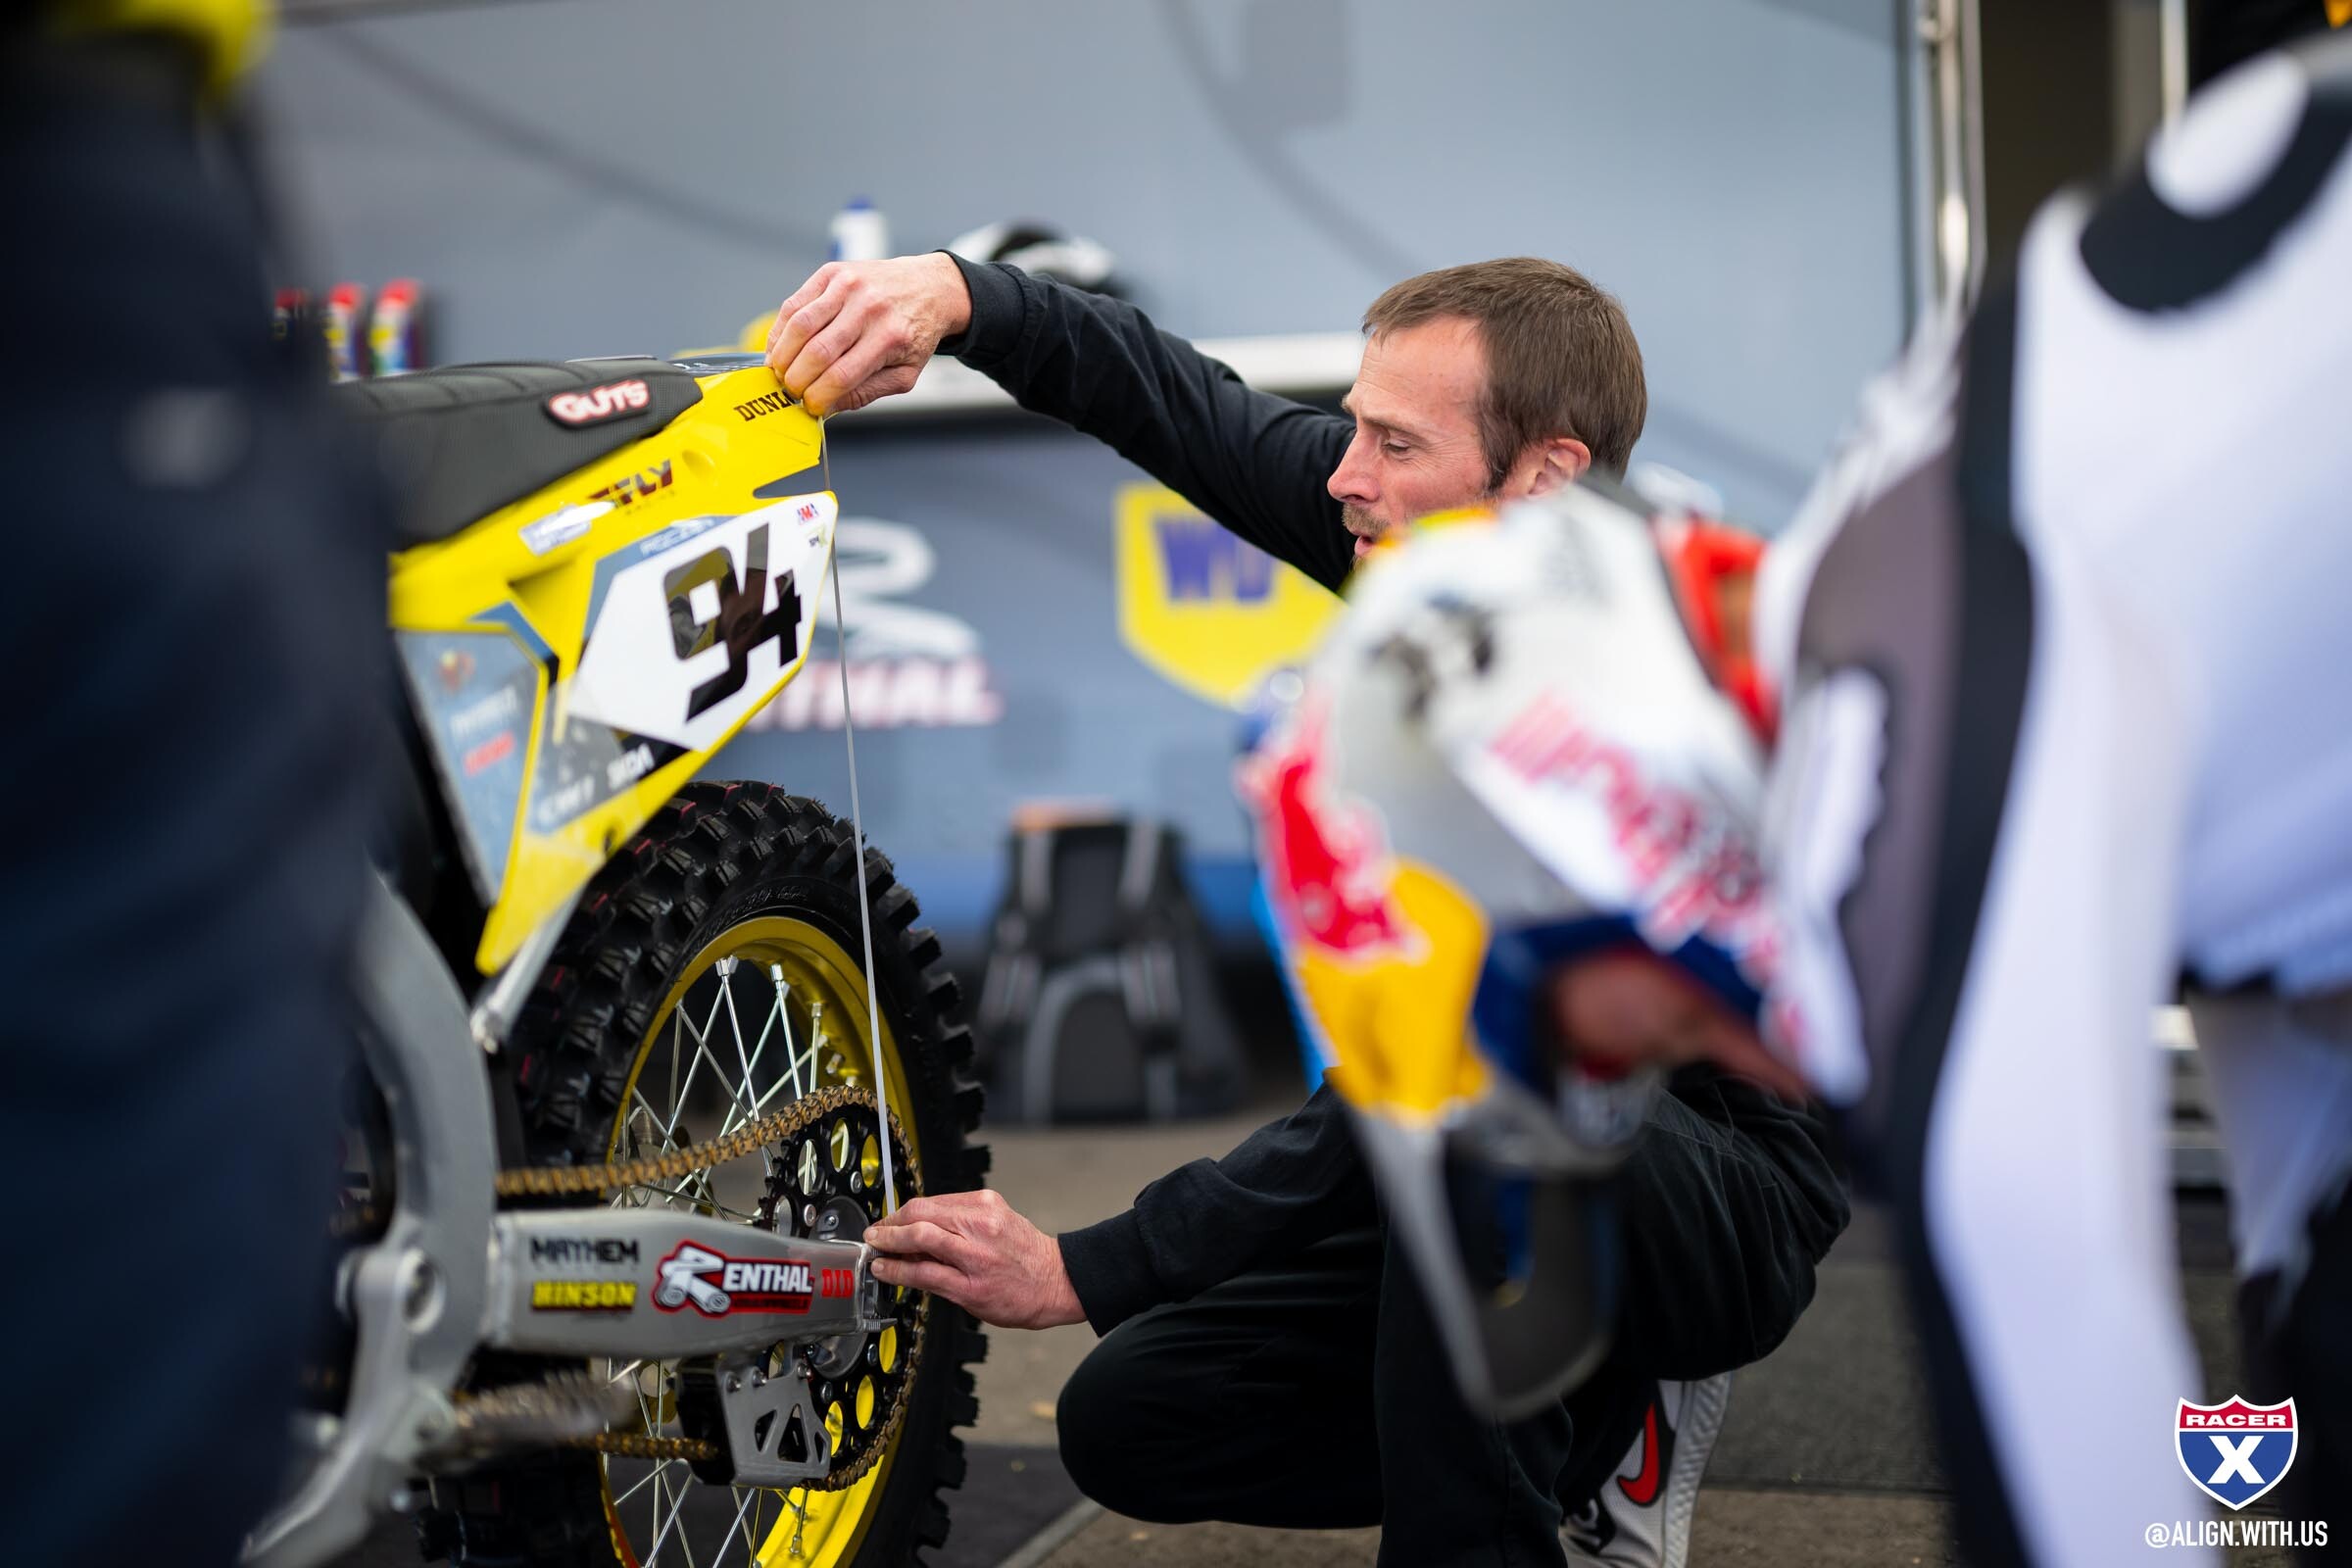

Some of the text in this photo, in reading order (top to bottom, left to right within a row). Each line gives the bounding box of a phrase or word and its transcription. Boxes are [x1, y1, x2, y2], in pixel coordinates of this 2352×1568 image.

[549, 379, 649, 423] GUTS
[615, 460, 673, 507] FLY
[663, 522, 803, 722] 94
[530, 1238, 640, 1264] MAYHEM
[821, 1269, 855, 1298] DID
